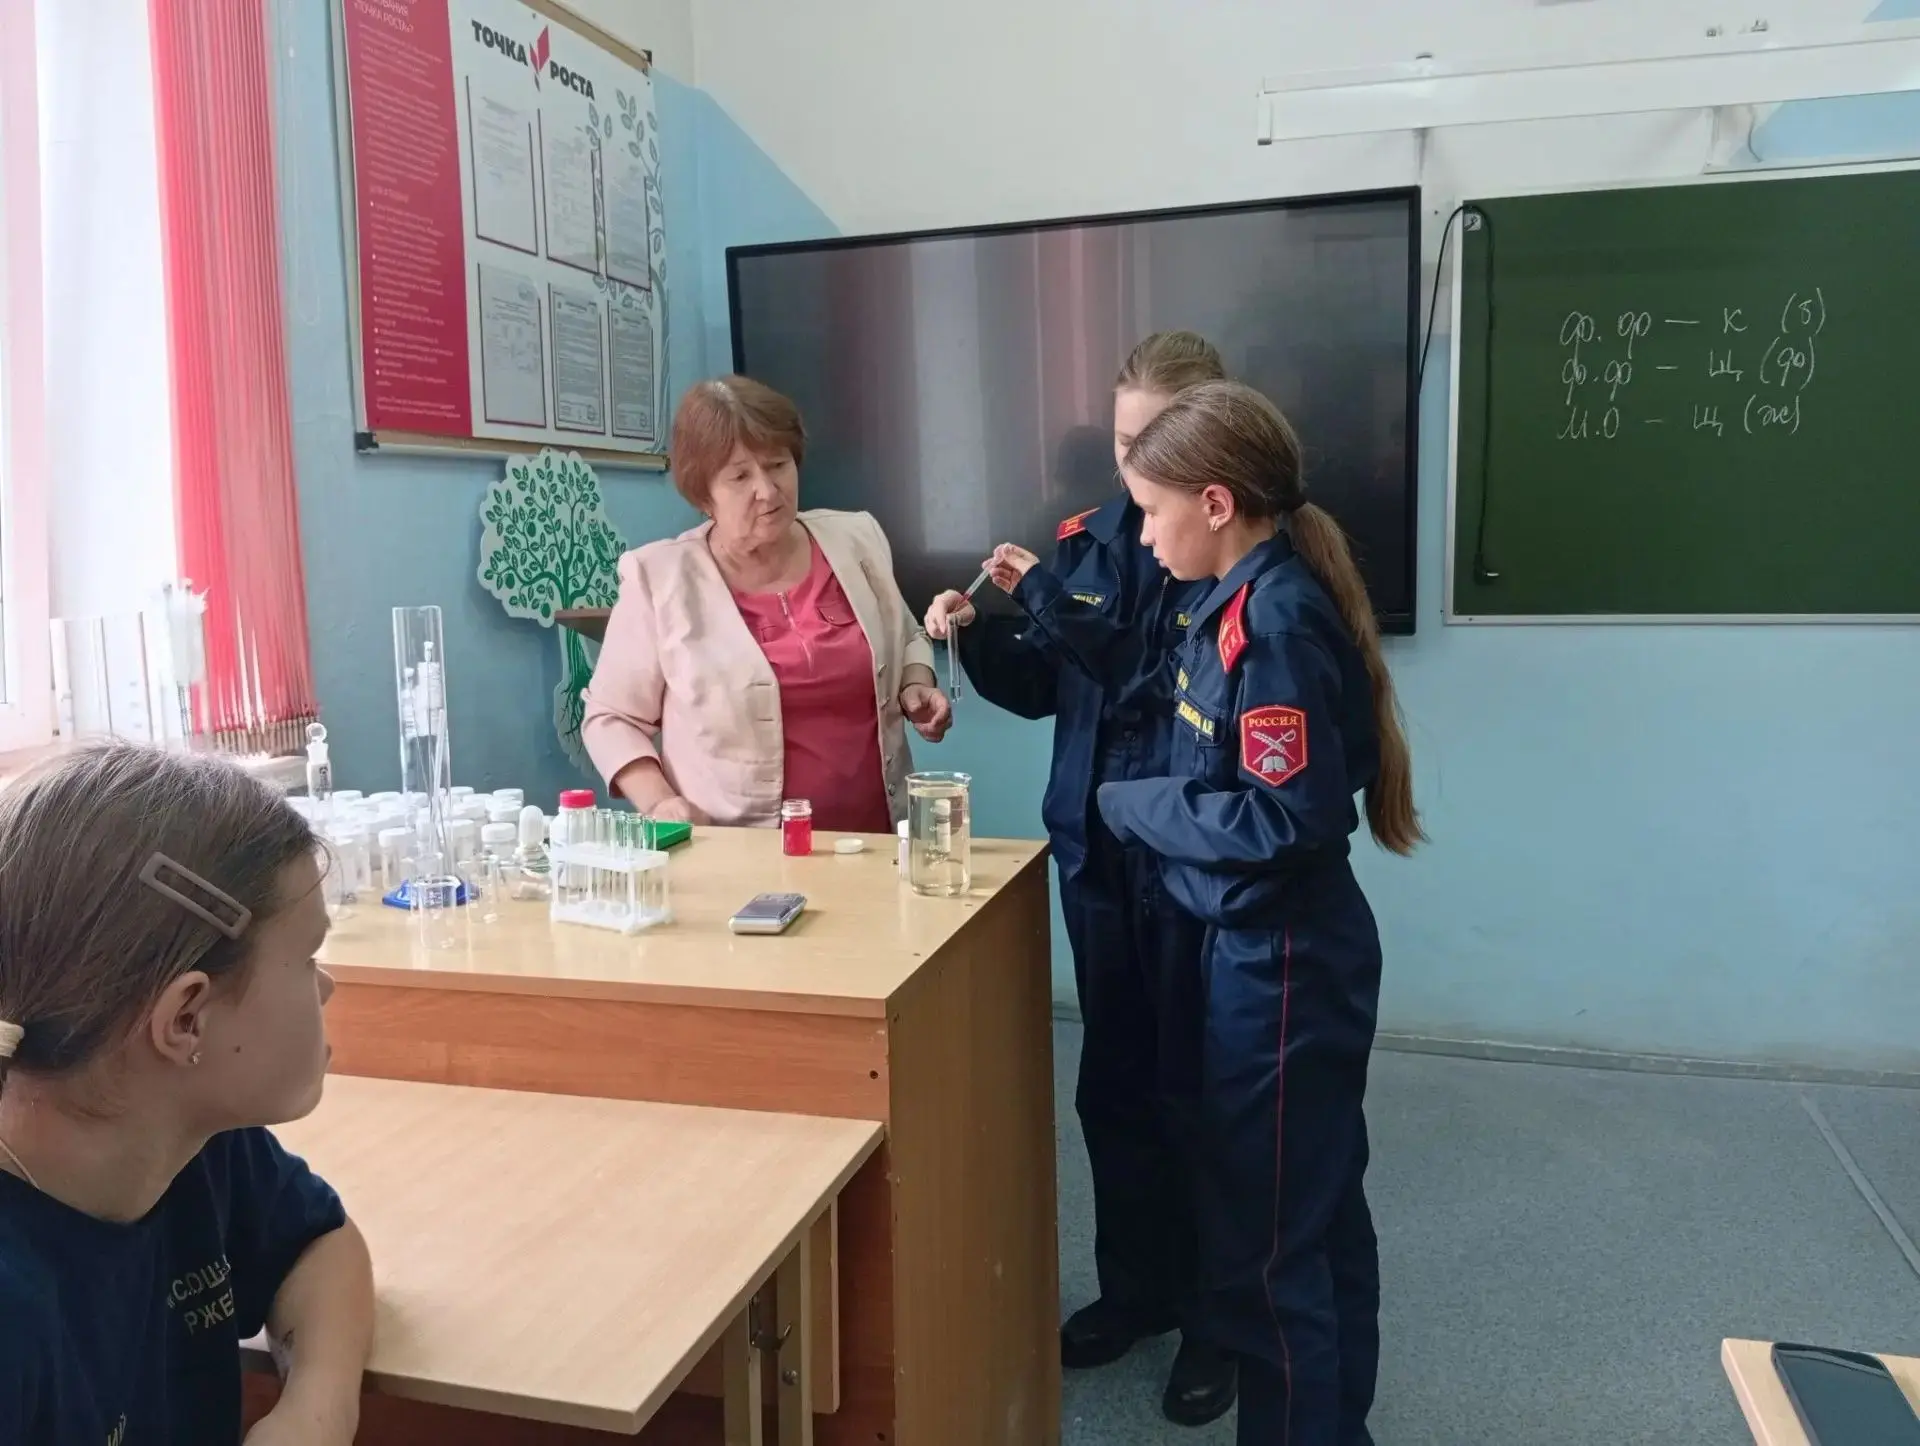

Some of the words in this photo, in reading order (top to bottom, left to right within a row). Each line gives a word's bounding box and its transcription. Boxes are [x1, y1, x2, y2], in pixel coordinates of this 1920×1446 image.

[471, 19, 529, 67] ТОЧКА
[550, 60, 595, 101] РОСТА
[1248, 715, 1298, 728] РОССИЯ
